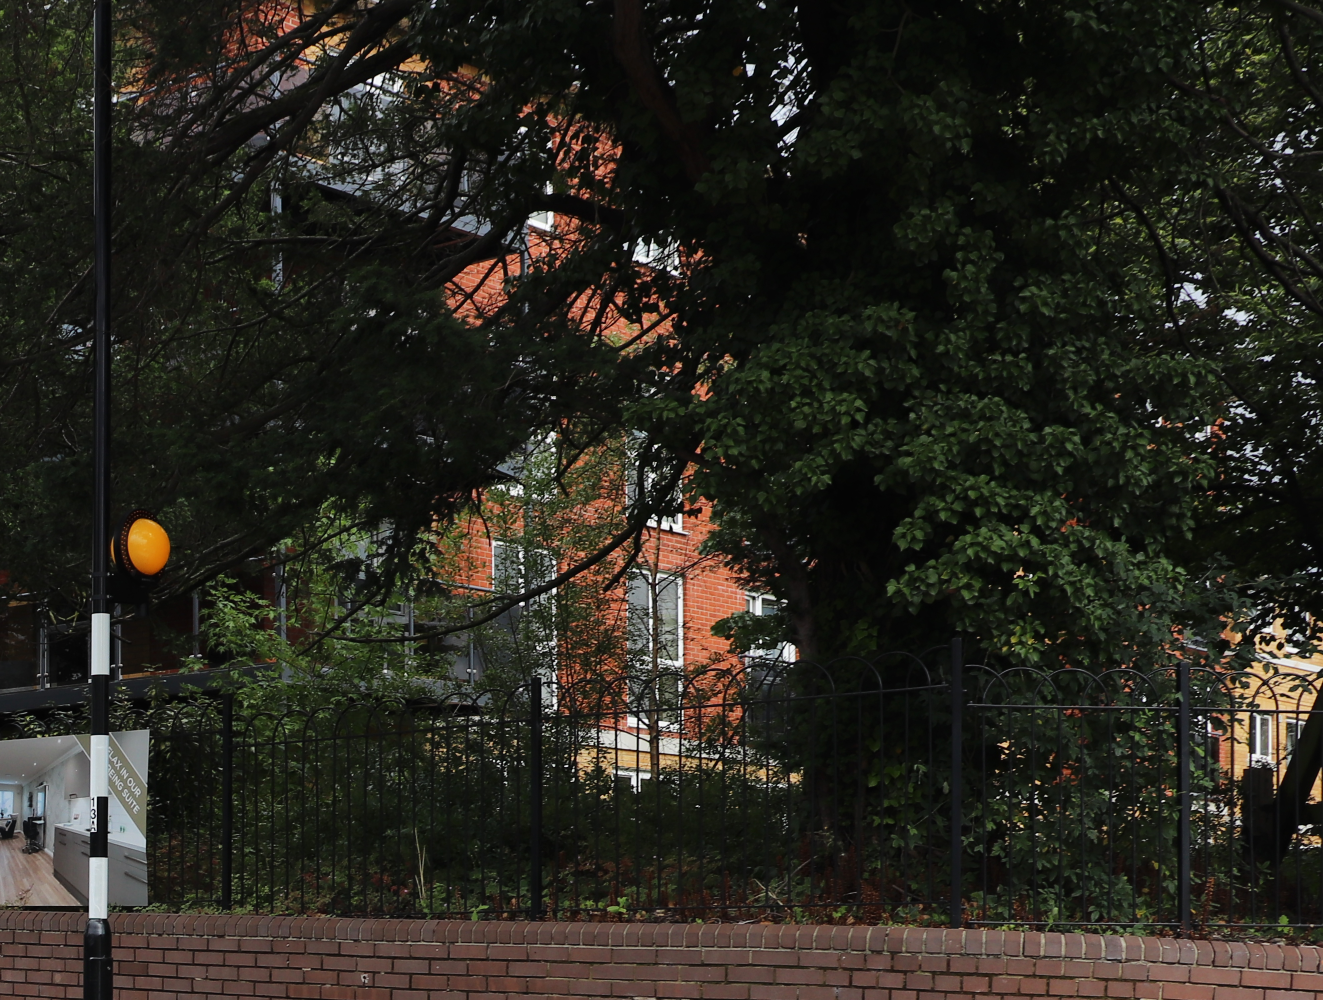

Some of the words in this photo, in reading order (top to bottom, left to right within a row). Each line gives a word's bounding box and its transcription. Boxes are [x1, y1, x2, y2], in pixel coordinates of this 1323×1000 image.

[108, 746, 123, 770] ELAX
[120, 767, 129, 779] IN
[126, 777, 142, 798] OUR
[121, 789, 140, 814] SUITE
